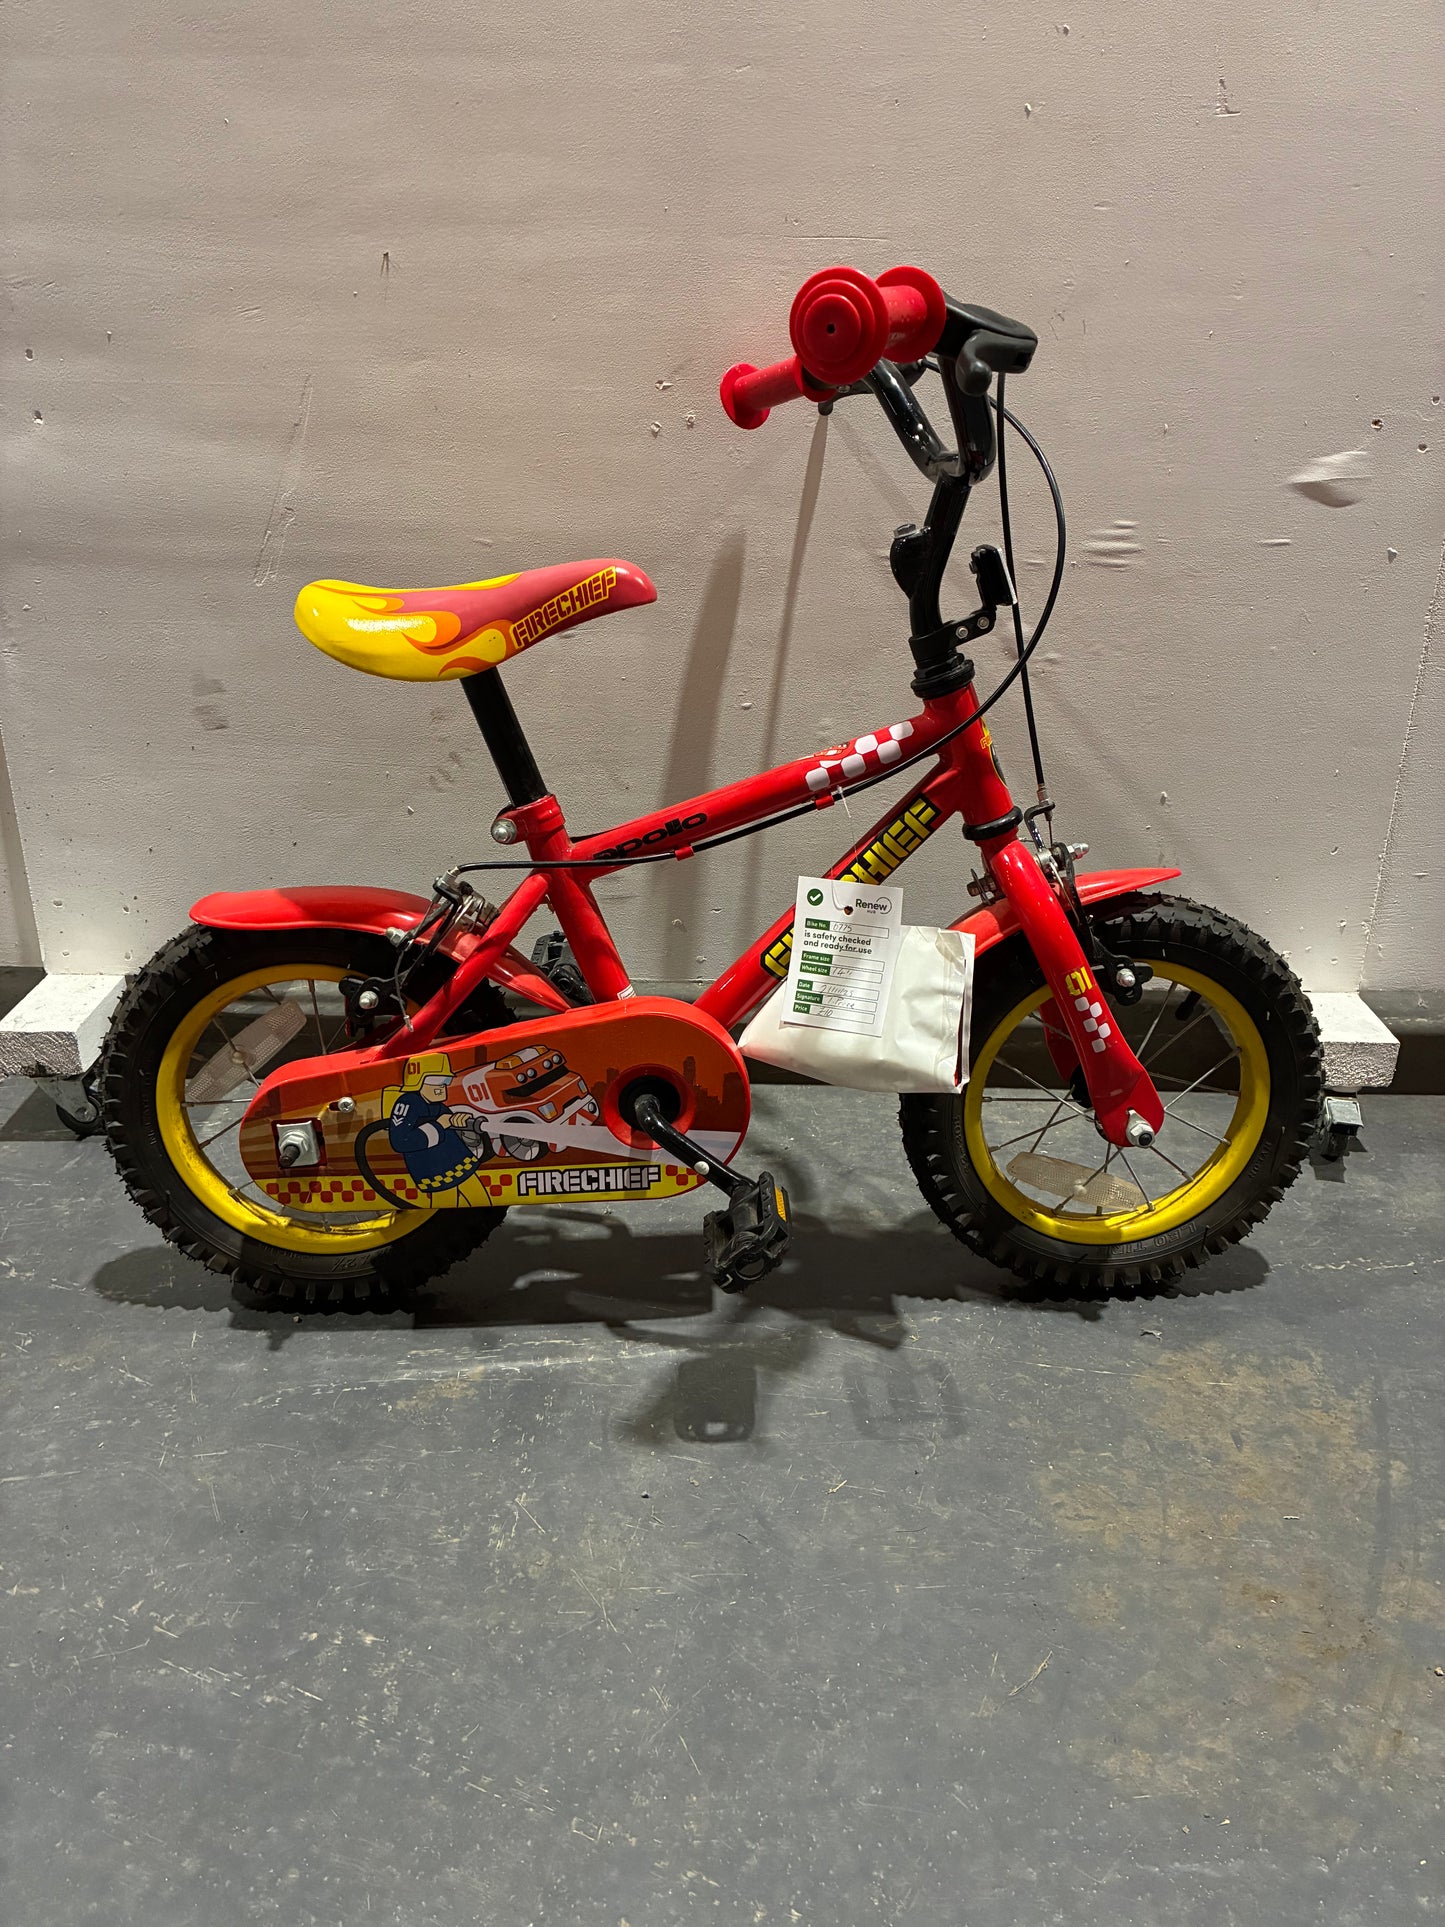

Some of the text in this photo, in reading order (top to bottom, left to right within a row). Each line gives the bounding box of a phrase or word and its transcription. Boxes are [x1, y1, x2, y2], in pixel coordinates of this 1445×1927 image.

[511, 568, 615, 648] FIRECHIEF
[855, 899, 887, 911] Renew
[804, 930, 871, 945] is safety checked
[821, 942, 843, 952] ready
[844, 943, 856, 951] for
[803, 952, 819, 960] Frame
[801, 963, 818, 971] Wheel
[796, 993, 820, 1002] Signature
[794, 1004, 808, 1012] Price
[518, 1166, 660, 1196] FIRECHIEF
